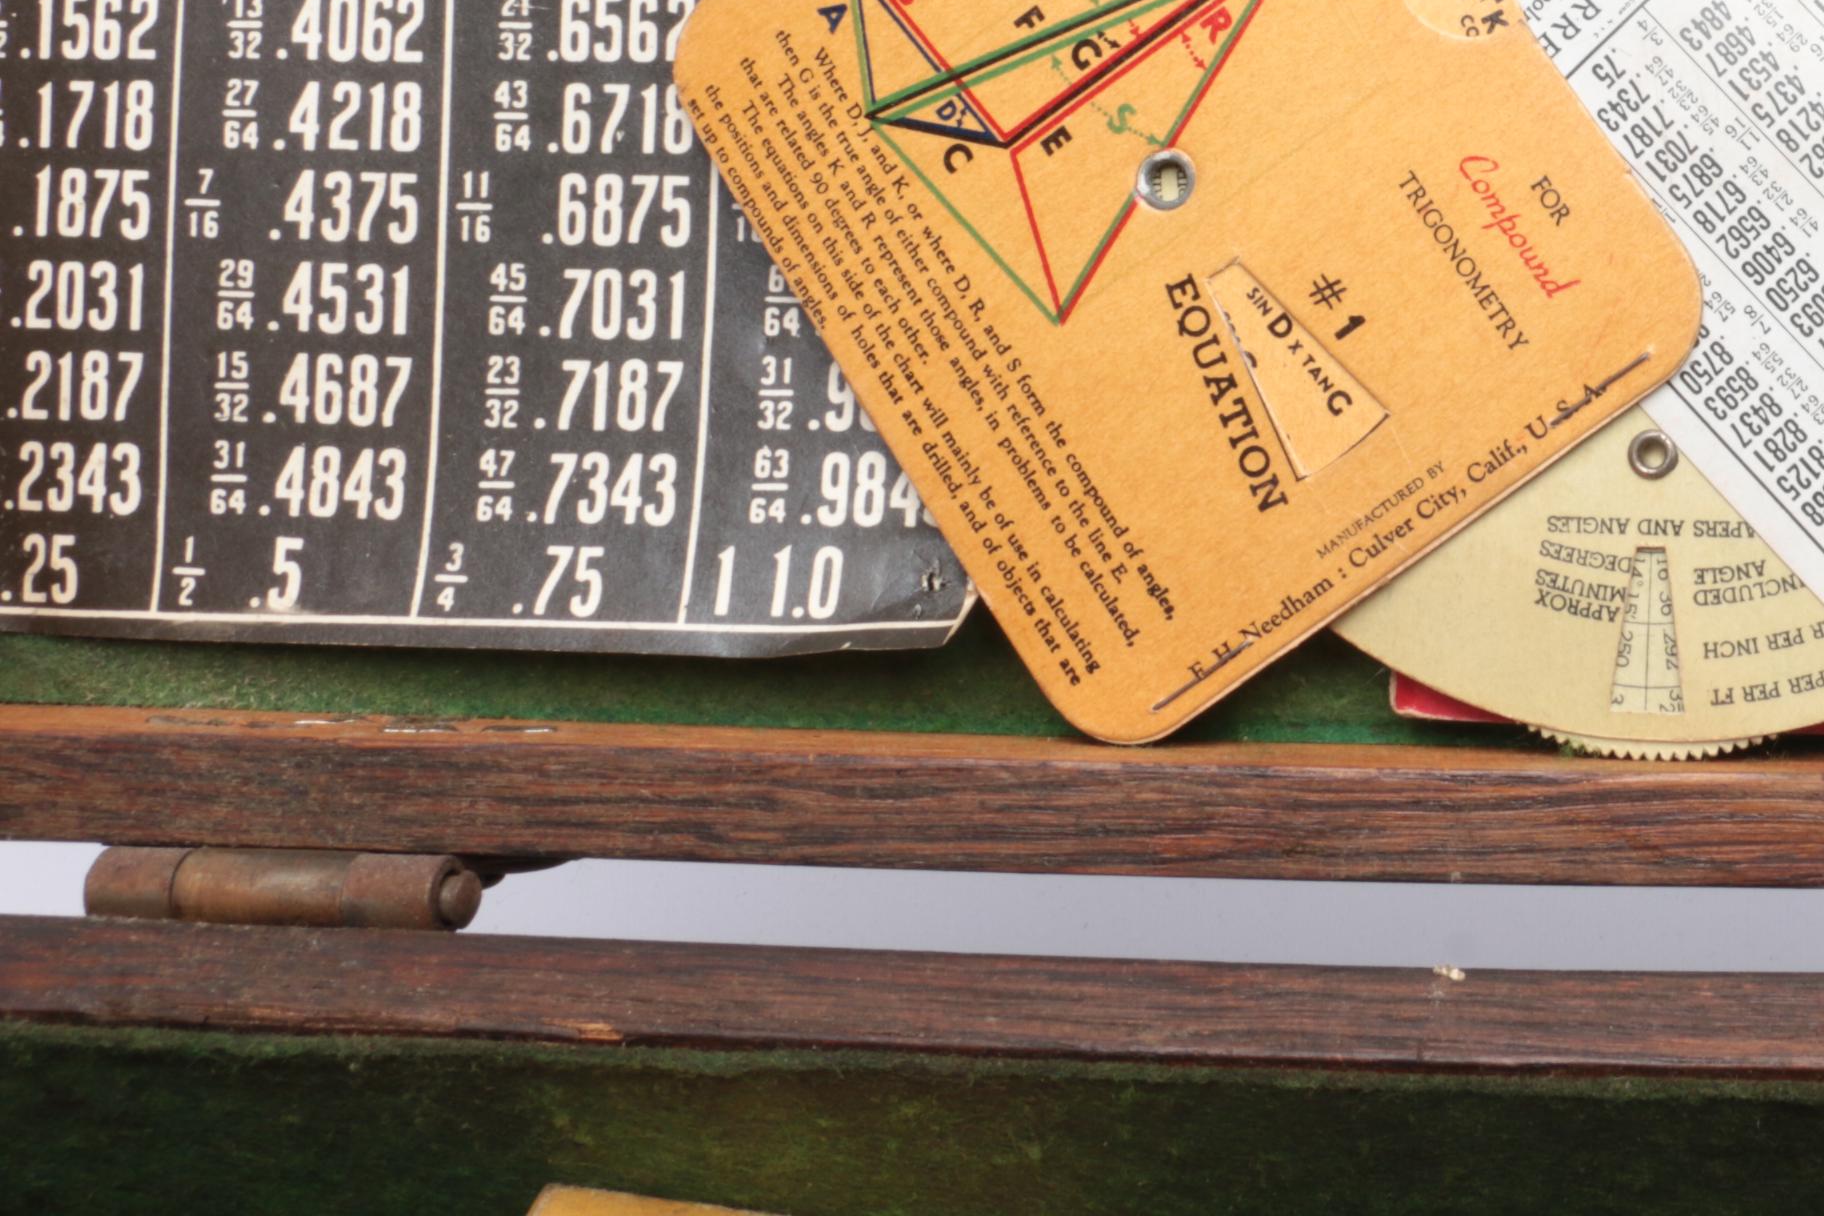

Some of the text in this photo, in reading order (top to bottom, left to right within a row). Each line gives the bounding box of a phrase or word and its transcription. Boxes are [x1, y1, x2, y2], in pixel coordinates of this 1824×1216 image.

[817, 4, 847, 33] A
[1014, 6, 1045, 32] F
[1071, 39, 1101, 71] G
[20, 80, 153, 150] .1718
[274, 81, 421, 151] .4218
[1040, 126, 1072, 156] E
[942, 144, 973, 174] C
[14, 166, 149, 240] .1875
[543, 173, 690, 247] .6875
[718, 113, 838, 301] positions dimensions
[1458, 155, 1582, 299] Compound
[1530, 175, 1570, 227] FOR
[1399, 170, 1529, 350] TRIGONOMETRY
[268, 262, 408, 334] .4531
[814, 46, 1175, 621] Where where form the compound angles,
[1308, 274, 1366, 341] # 1
[9, 351, 143, 420] .2187
[535, 359, 683, 431] .7187
[1162, 274, 1289, 514] EQUATION
[1006, 404, 1057, 477] reference
[260, 446, 406, 520] .4843
[527, 452, 676, 526] .7343
[1316, 460, 1445, 560] MANUFACTURED BY
[997, 437, 1139, 647] problems calculated,
[1538, 539, 1632, 573] DEGREES
[1547, 515, 1684, 537] AND ANGLES
[249, 537, 303, 610] .5
[513, 546, 604, 618] .75
[770, 545, 843, 619] 1.0
[1238, 578, 1334, 647] Needham
[1349, 516, 1415, 568] Culver
[1415, 485, 1467, 520] City,
[1534, 568, 1627, 603] MINUTES
[1693, 559, 1767, 585] ANGLE
[1533, 588, 1620, 622] APPROX
[1703, 627, 1805, 660] PER INCH
[1710, 687, 1734, 706] FT
[1741, 681, 1781, 703] PER
